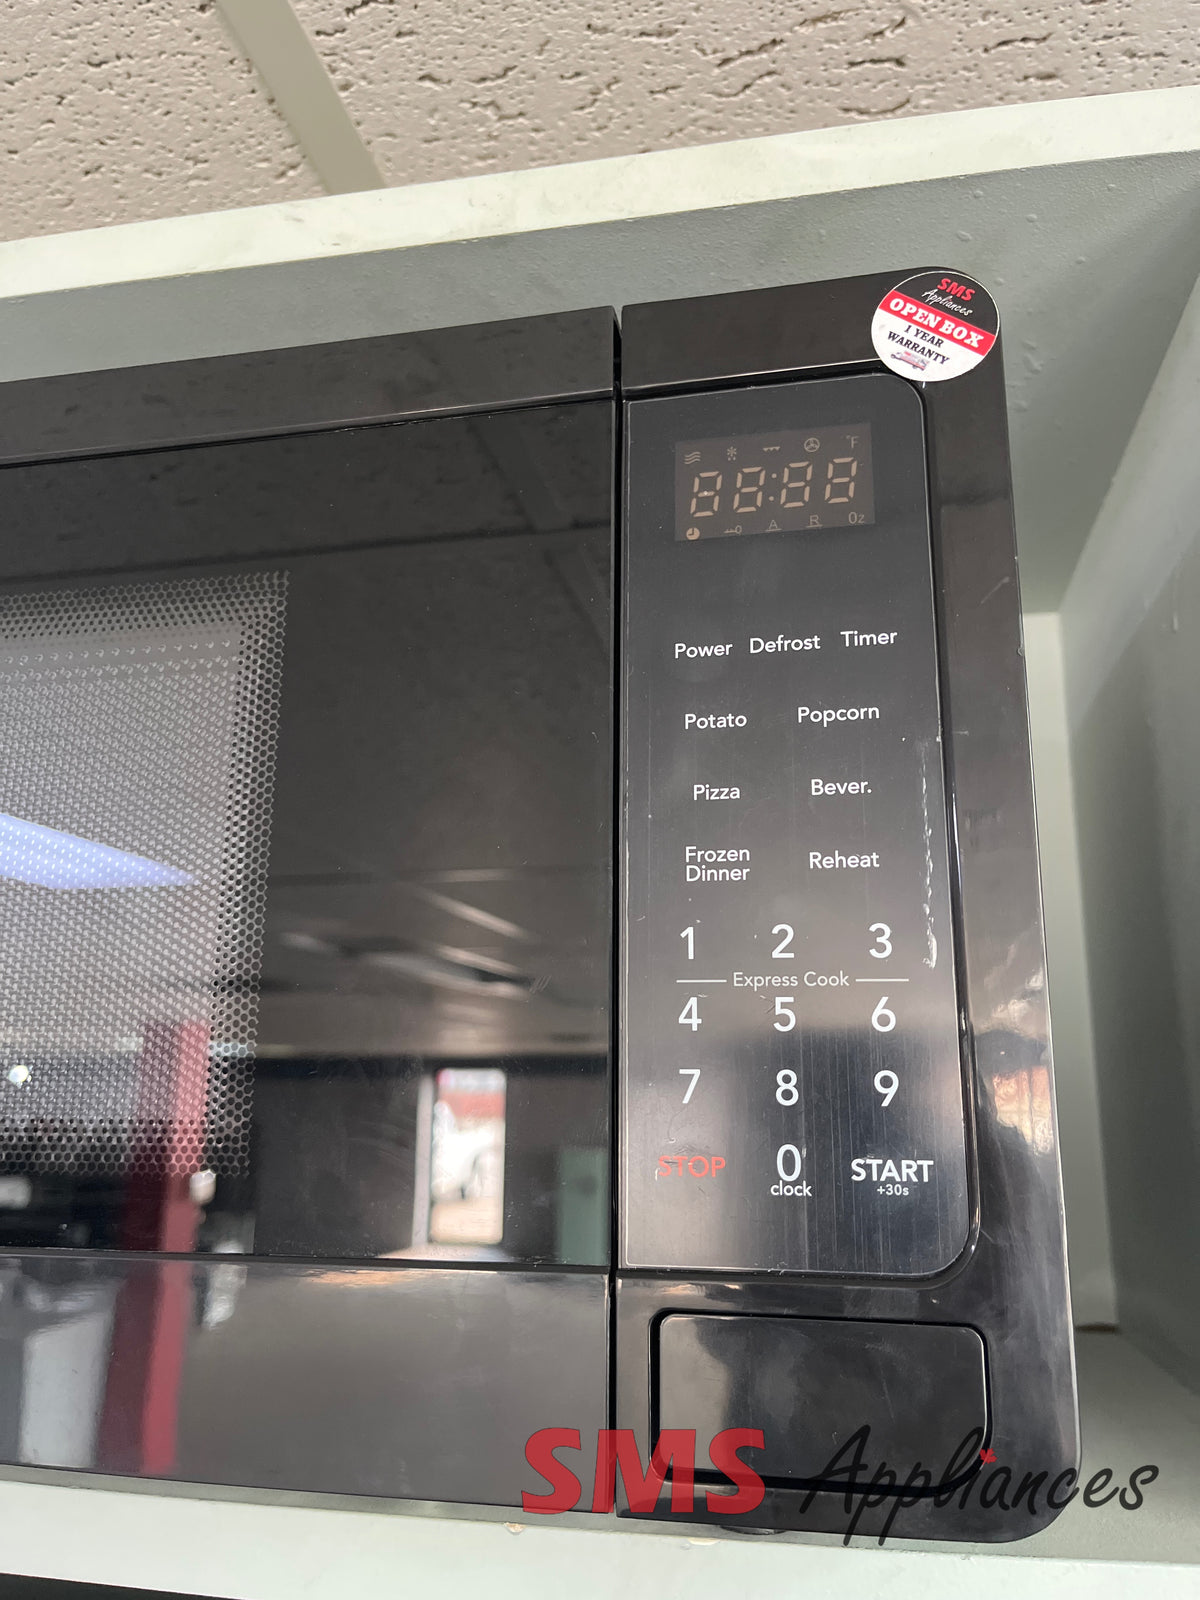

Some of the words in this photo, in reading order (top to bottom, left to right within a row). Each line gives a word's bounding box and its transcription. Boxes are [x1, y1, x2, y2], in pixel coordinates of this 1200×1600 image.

[921, 288, 973, 316] Appliances
[937, 278, 976, 301] SMS
[889, 298, 942, 329] OPEN
[939, 319, 984, 348] BOX
[904, 325, 912, 333] 1
[914, 328, 945, 348] YEAR
[887, 331, 950, 365] WARRANTY
[690, 457, 858, 518] 88:88
[674, 642, 733, 659] Power
[749, 635, 821, 654] Defrost
[840, 630, 898, 647] Timer
[684, 712, 747, 729] Potato
[797, 706, 880, 727] Popcorn
[693, 784, 741, 800] Pizza
[811, 778, 872, 796] Bever.
[685, 846, 750, 863] Frozen
[809, 850, 880, 869] Reheat
[686, 865, 750, 882] Dinner
[680, 926, 695, 960] 1
[771, 923, 795, 959] 2
[868, 923, 893, 959] 3
[733, 971, 798, 991] Express
[803, 971, 850, 987] Cook
[678, 996, 702, 1031] 4
[773, 996, 796, 1032] 5
[871, 996, 897, 1032] 6
[679, 1068, 701, 1104] 7
[775, 1069, 799, 1106] 8
[873, 1070, 899, 1107] 9
[658, 1155, 726, 1178] STOP
[776, 1144, 801, 1182] 0
[850, 1159, 934, 1182] START
[770, 1180, 812, 1197] clock
[876, 1185, 909, 1196] +30s
